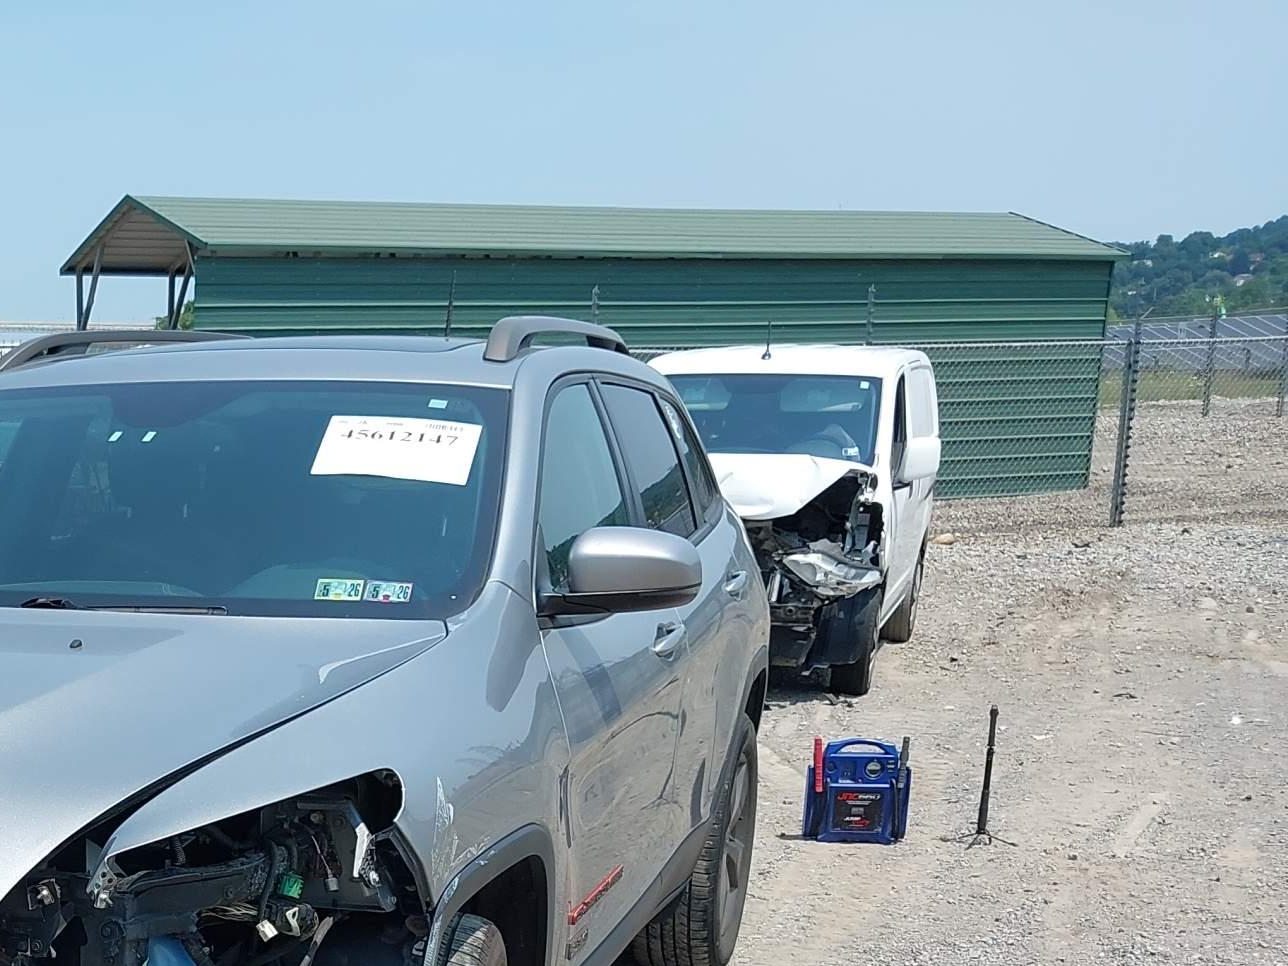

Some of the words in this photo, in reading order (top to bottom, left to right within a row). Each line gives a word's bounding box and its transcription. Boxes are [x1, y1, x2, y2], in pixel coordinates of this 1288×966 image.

[340, 429, 459, 446] 45612147
[348, 583, 361, 597] 26
[397, 585, 410, 600] 26
